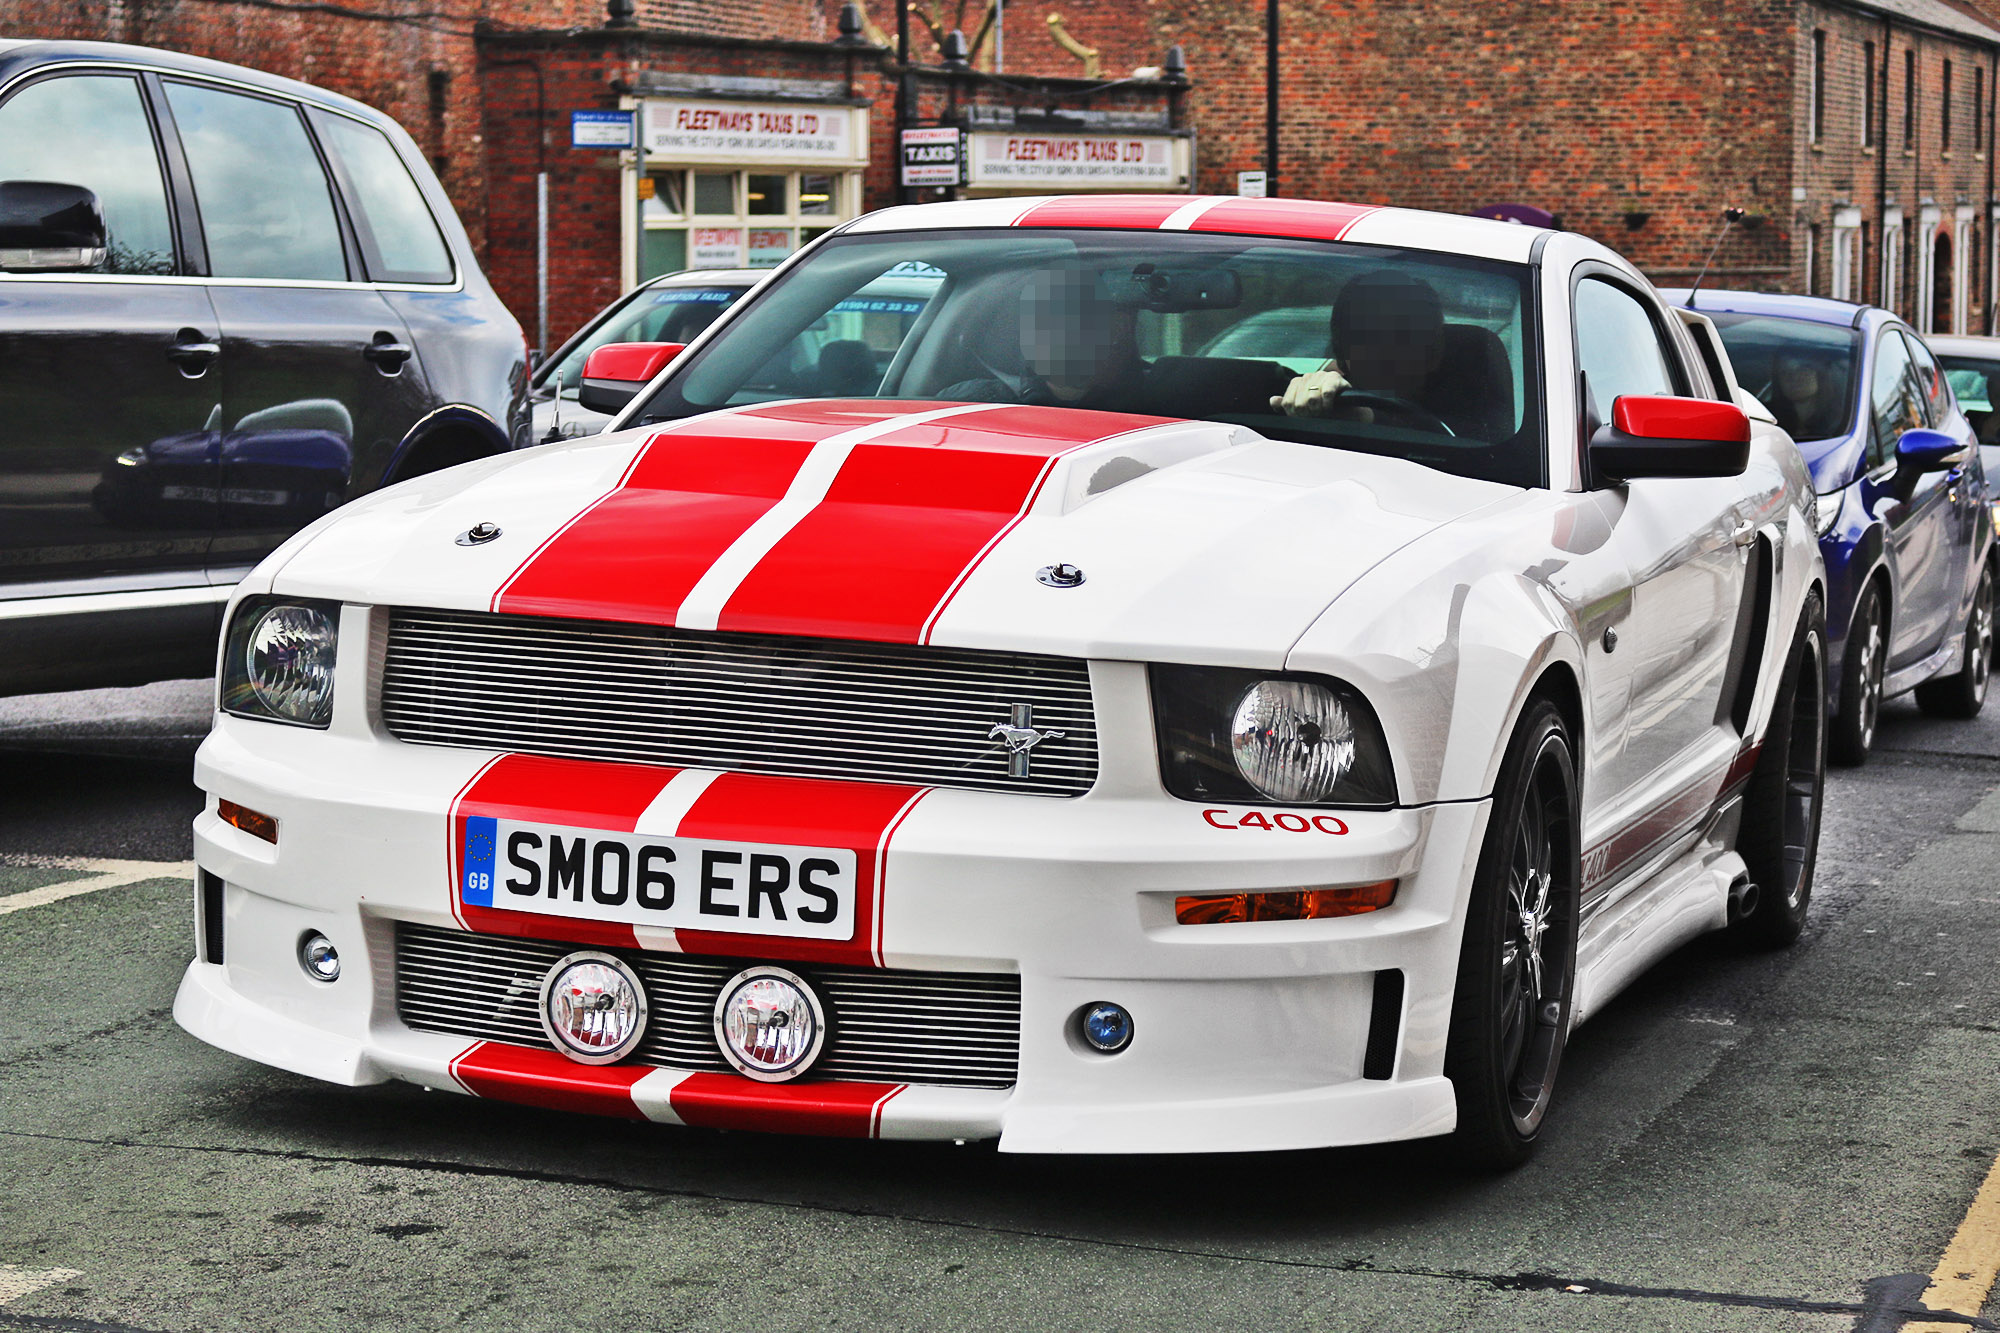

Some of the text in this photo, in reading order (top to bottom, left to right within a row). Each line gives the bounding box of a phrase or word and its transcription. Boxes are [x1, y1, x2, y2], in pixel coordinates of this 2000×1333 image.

[677, 109, 819, 135] FLEETWAYS TAXIS LTD
[905, 145, 955, 162] TAXIS
[1006, 138, 1145, 162] FLEETWAYS TAXIS LTD
[1202, 809, 1349, 835] C400
[468, 872, 489, 890] GB
[700, 849, 840, 924] ERS
